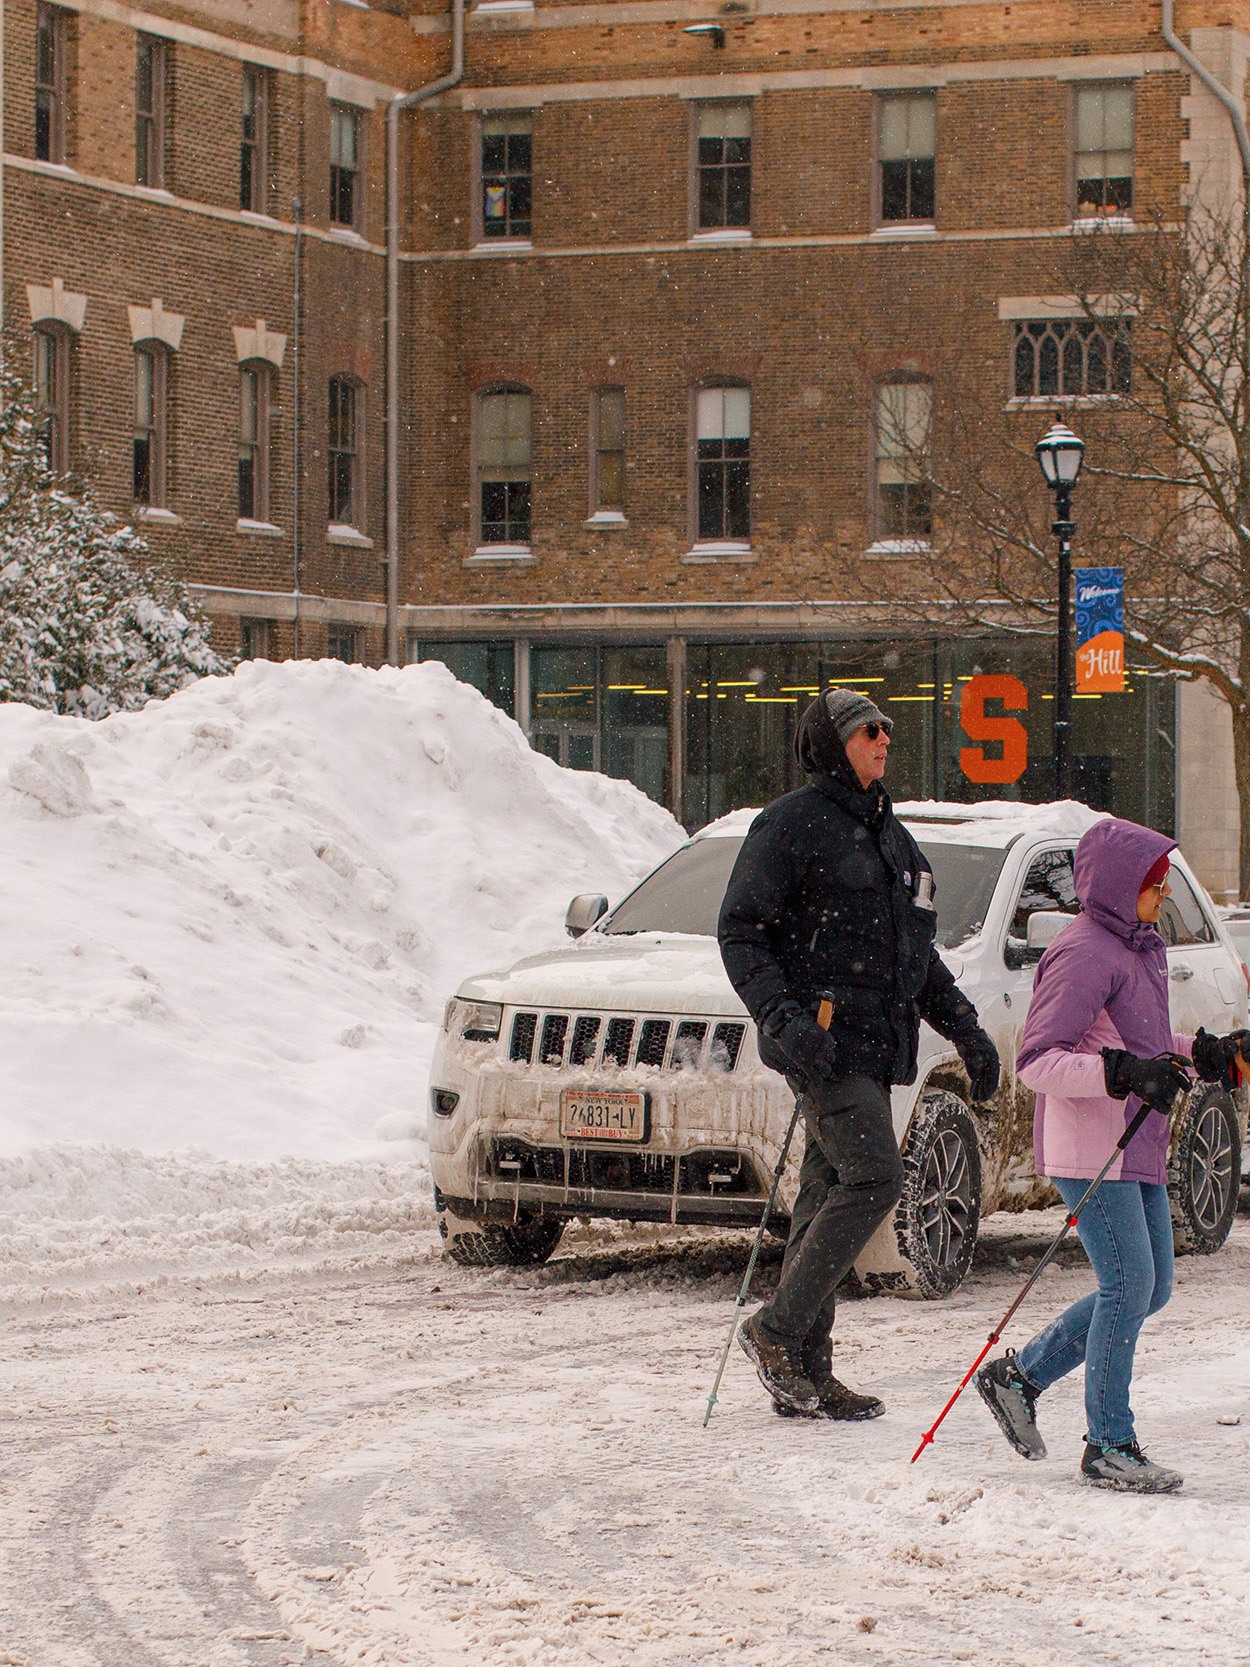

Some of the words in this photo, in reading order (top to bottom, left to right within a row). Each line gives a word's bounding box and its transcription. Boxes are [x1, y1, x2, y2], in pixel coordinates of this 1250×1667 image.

[1079, 585, 1121, 602] Welcome
[1085, 648, 1122, 679] Hill
[959, 674, 1028, 784] S
[585, 1097, 602, 1105] NEW
[604, 1098, 624, 1106] YORK
[580, 1127, 599, 1137] BEST
[608, 1128, 624, 1138] BUY
